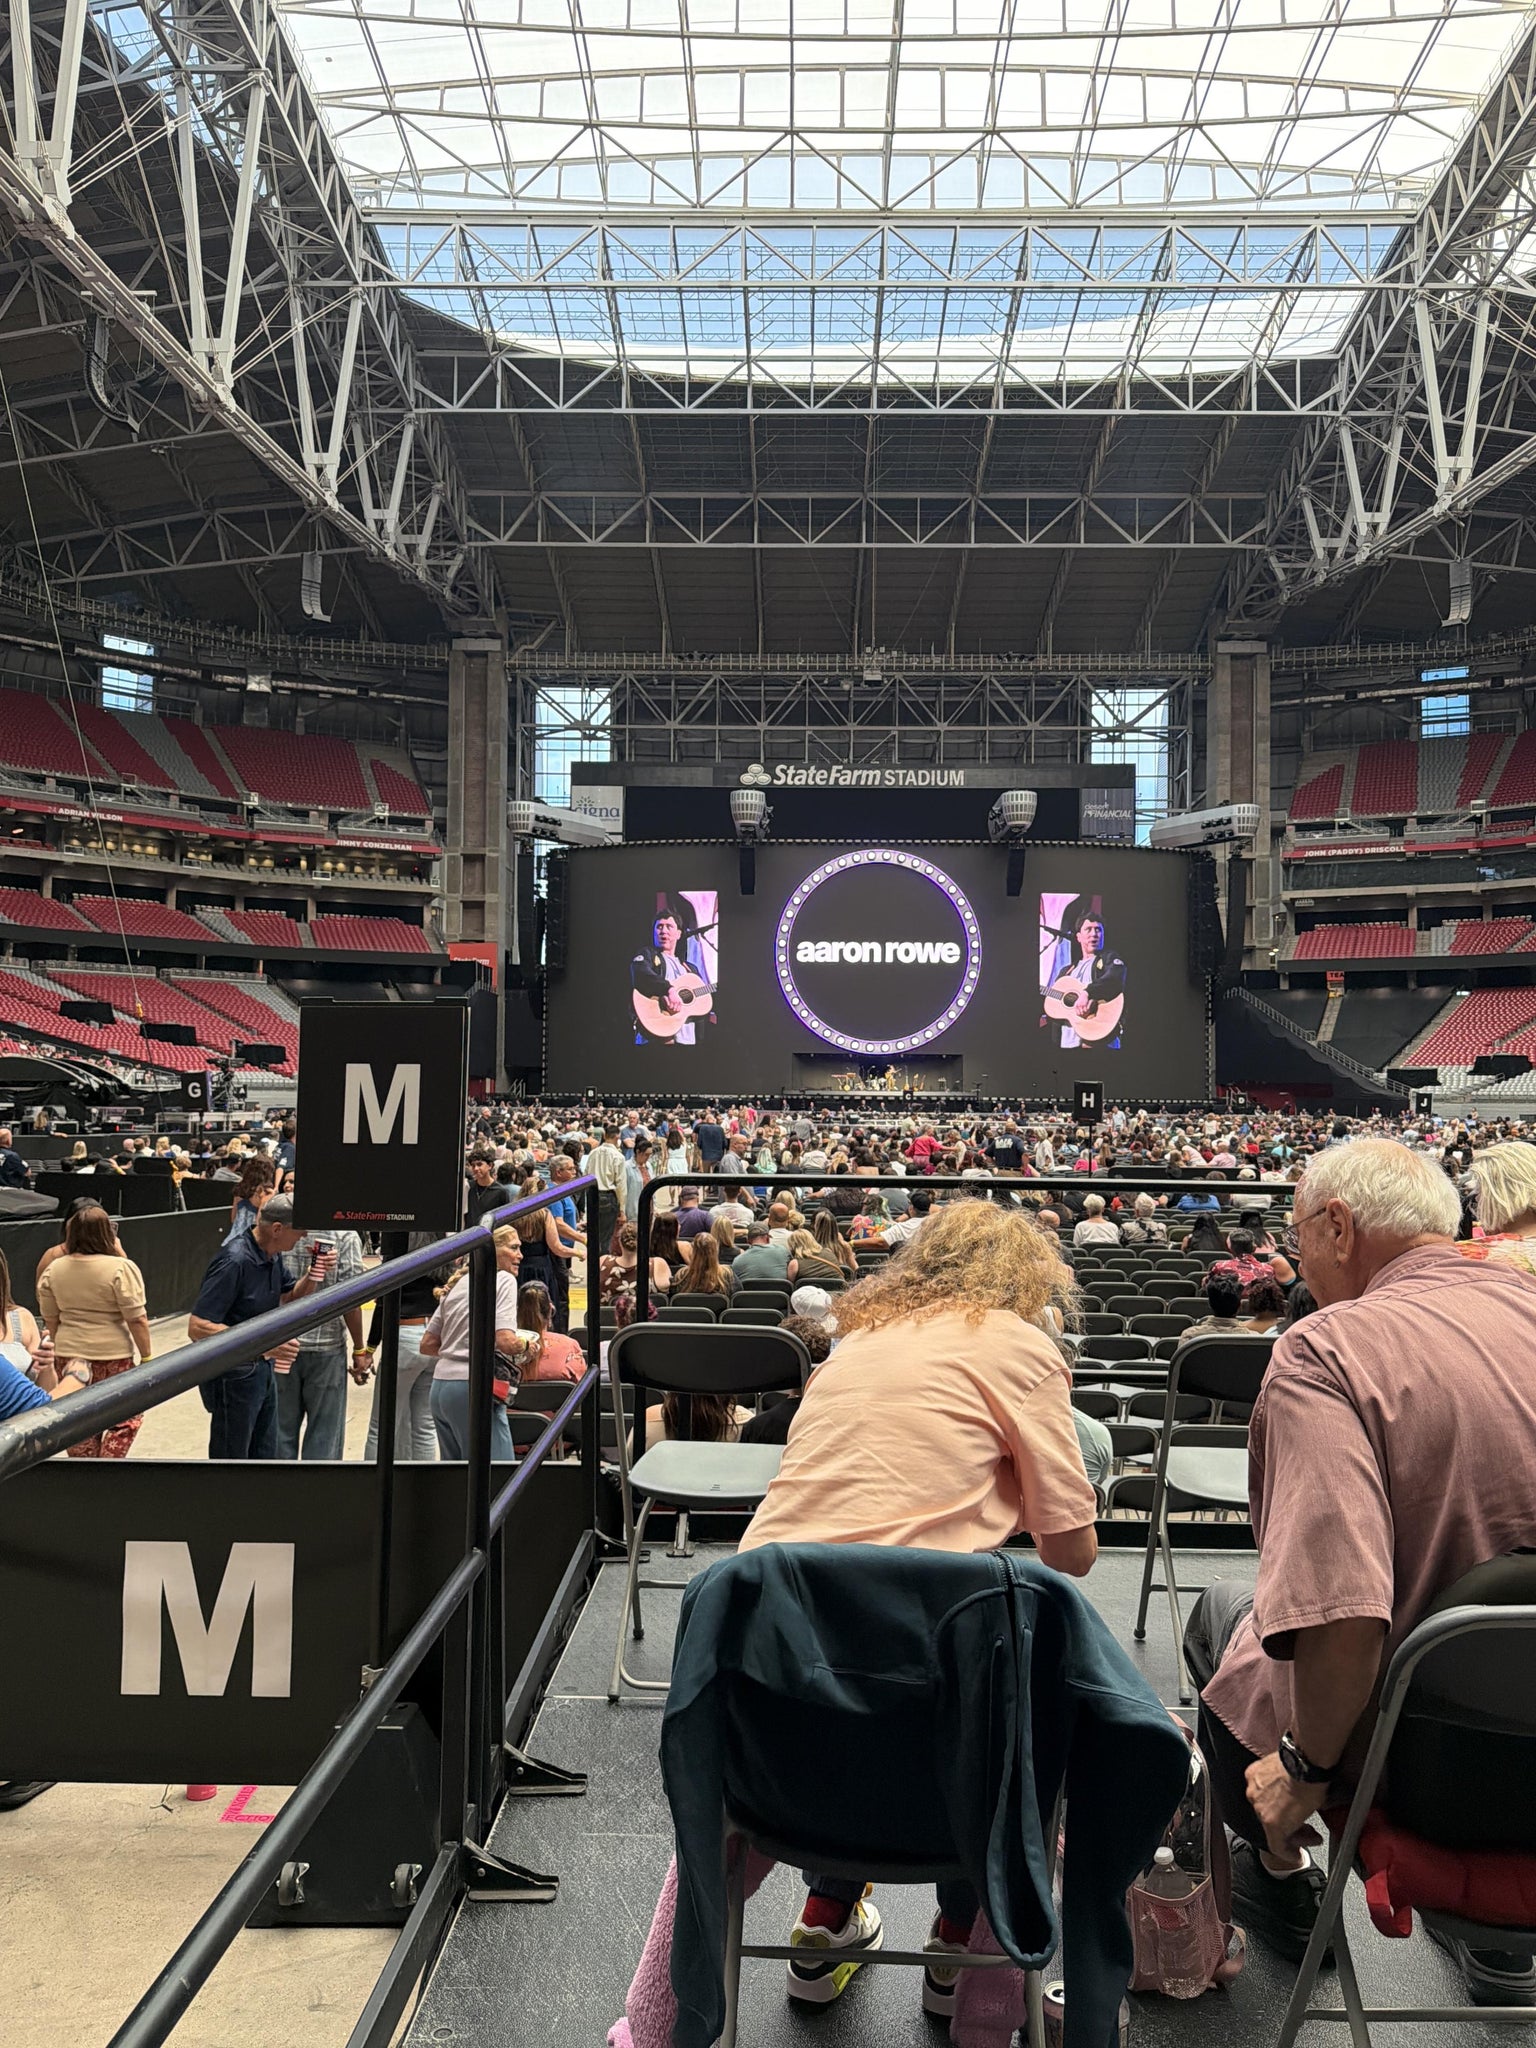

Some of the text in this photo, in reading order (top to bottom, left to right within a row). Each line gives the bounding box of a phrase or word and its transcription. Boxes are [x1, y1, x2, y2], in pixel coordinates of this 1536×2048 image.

[884, 770, 965, 786] STADIUM
[58, 808, 90, 818] ADRIAN
[91, 812, 123, 822] WILSON
[336, 839, 412, 851] JIMMY CONZELMAN
[1328, 848, 1362, 856] (PADDY)
[1365, 846, 1406, 854] DRISCOLL
[796, 941, 961, 963] aaron rowe
[188, 1082, 202, 1098] G
[343, 1063, 421, 1144] M
[1082, 1092, 1095, 1108] H
[1420, 1098, 1428, 1107] J
[120, 1541, 295, 1698] M
